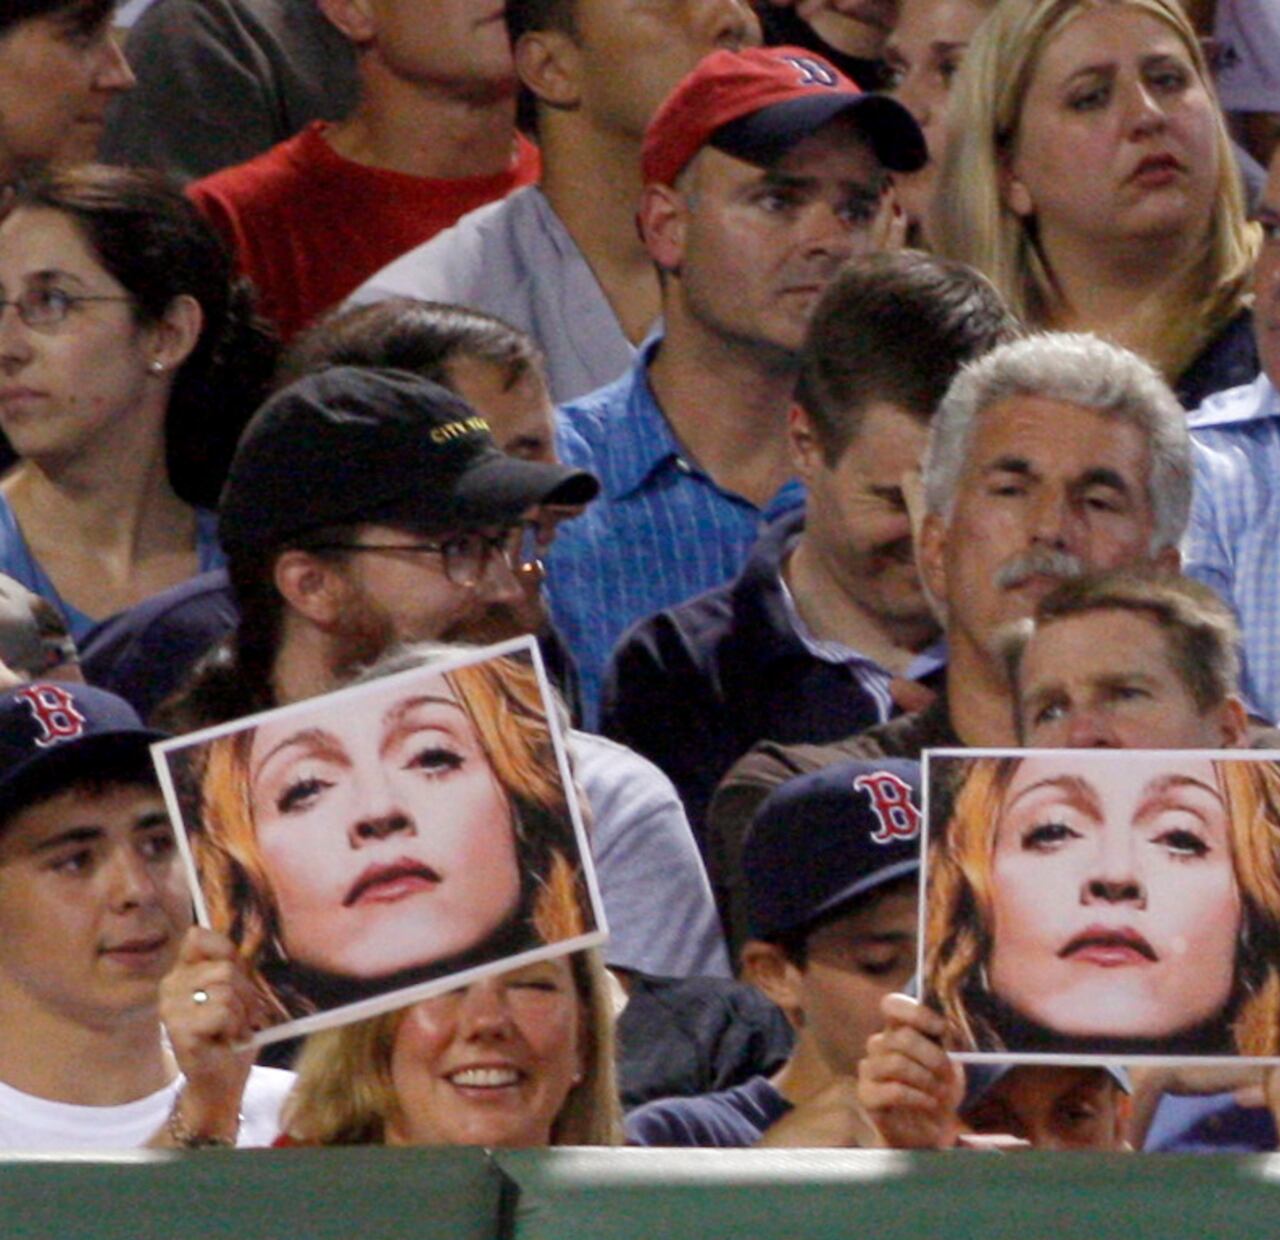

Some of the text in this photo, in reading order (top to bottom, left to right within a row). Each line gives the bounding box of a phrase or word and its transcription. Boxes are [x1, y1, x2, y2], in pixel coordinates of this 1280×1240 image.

[782, 55, 838, 87] B
[14, 681, 87, 748] B
[853, 770, 924, 844] B
